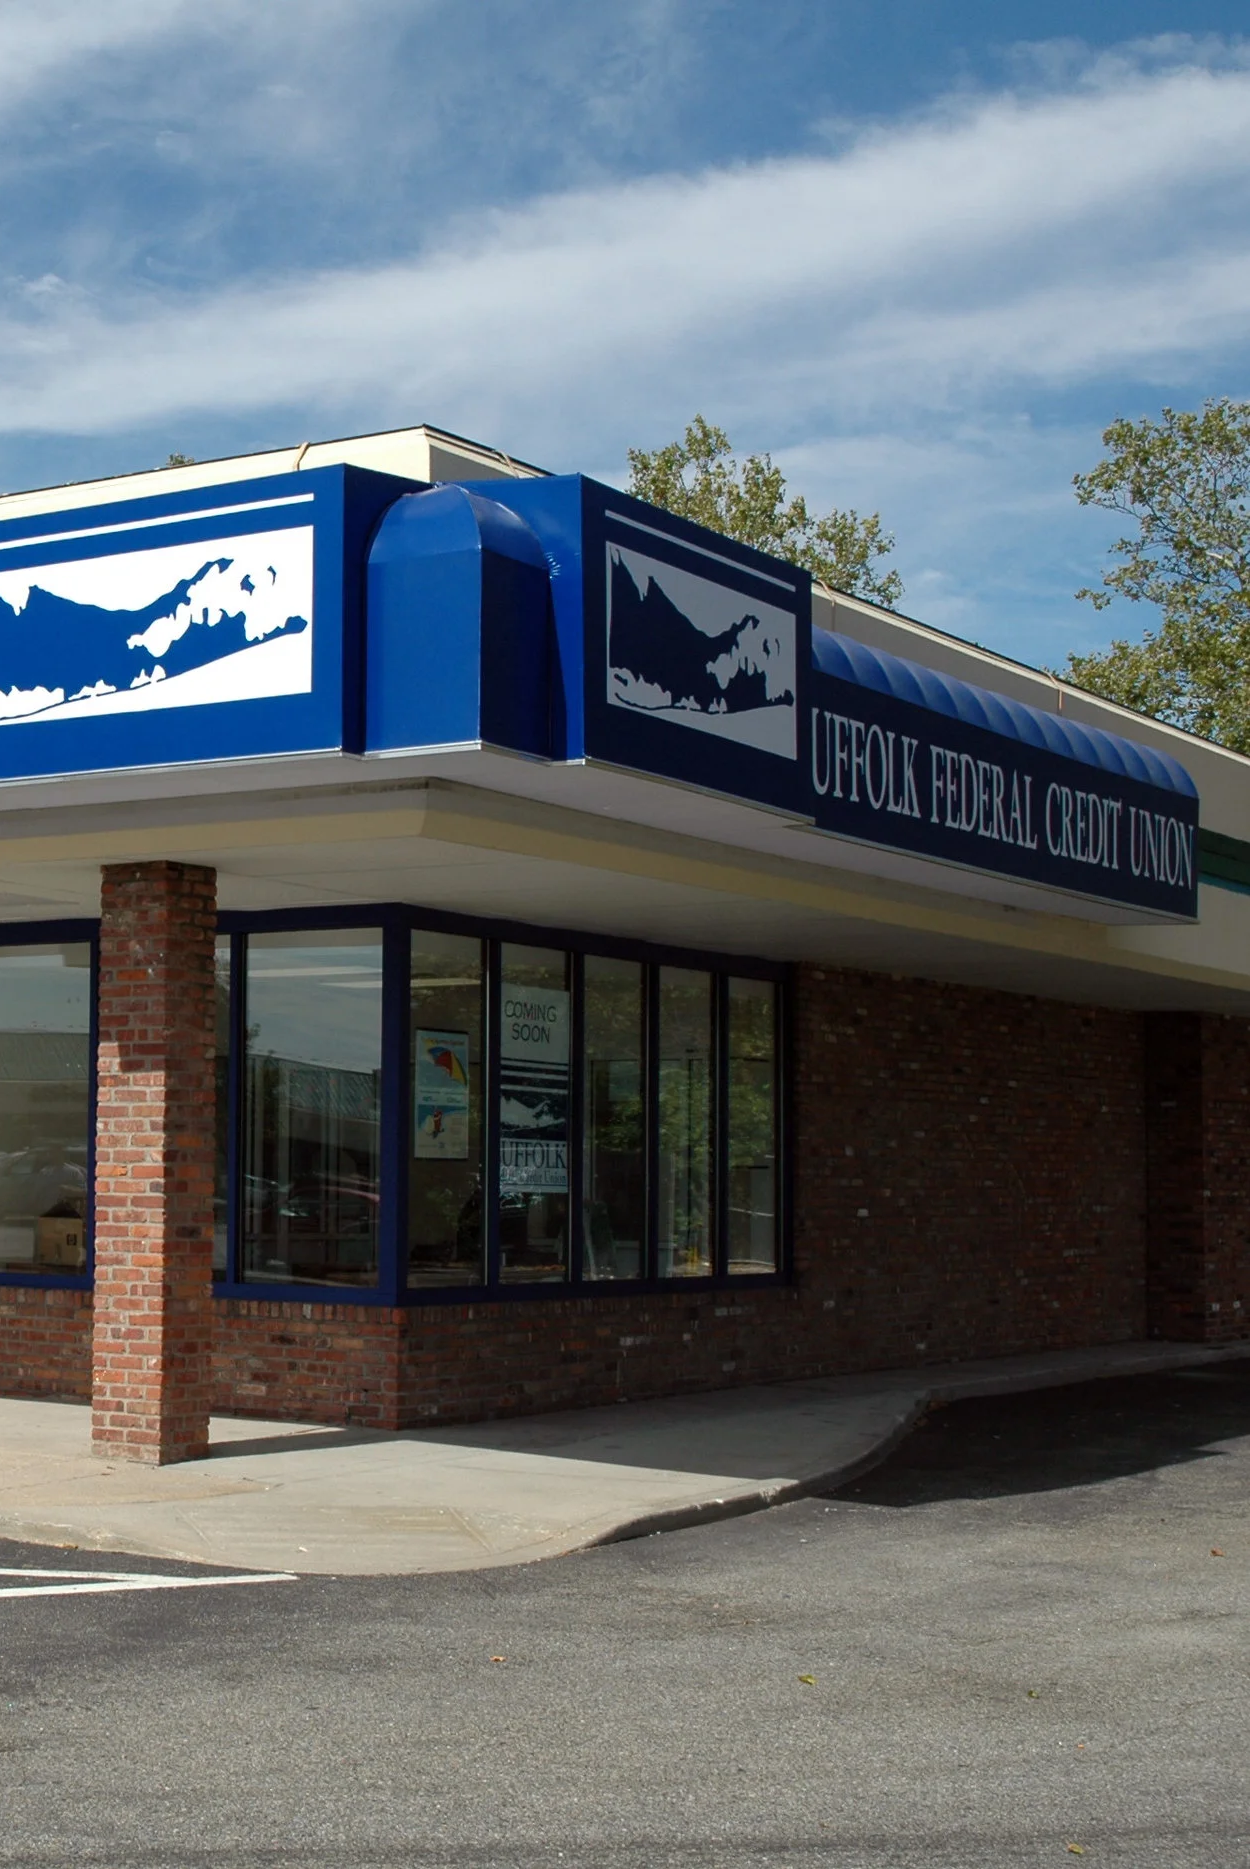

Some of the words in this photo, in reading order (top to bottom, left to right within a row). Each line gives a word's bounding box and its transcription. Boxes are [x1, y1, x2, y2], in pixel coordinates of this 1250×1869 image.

[811, 707, 922, 818] UFFOLK
[929, 744, 1038, 850] FEDERAL
[1045, 782, 1122, 870] CREDIT
[1129, 806, 1194, 890] UNION
[504, 1000, 557, 1022] COMING
[511, 1023, 551, 1044] SOON
[502, 1141, 567, 1169] UFFOLK
